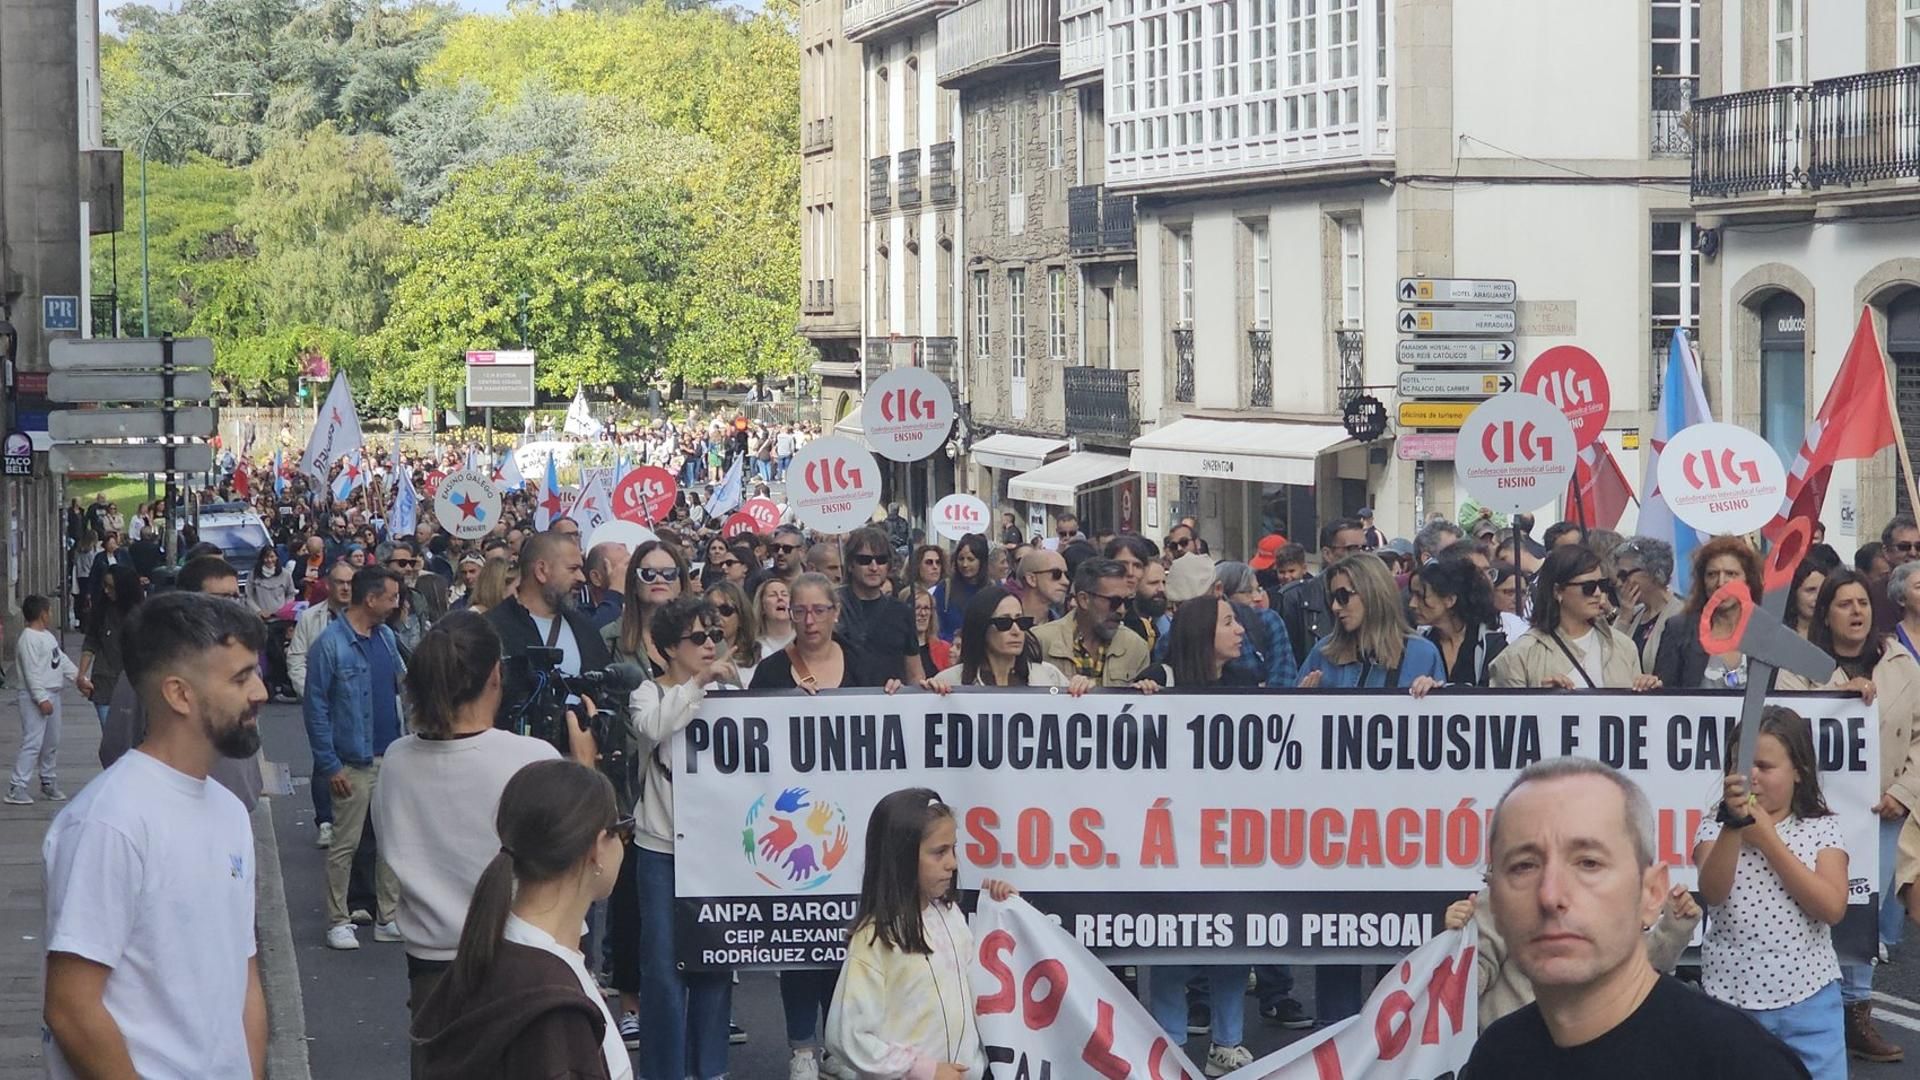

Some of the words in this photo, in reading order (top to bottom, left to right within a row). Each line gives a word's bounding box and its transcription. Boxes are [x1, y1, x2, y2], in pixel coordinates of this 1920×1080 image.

[48, 301, 72, 318] PR
[881, 388, 936, 422] CIG
[894, 432, 923, 442] ENSINO
[1482, 421, 1553, 463] CIG
[4, 457, 31, 466] TACO
[5, 466, 30, 474] BELL
[1683, 448, 1761, 490] CIG
[805, 457, 862, 494] CIG
[1498, 476, 1536, 488] ENSINO
[442, 474, 464, 500] ENSINO
[466, 473, 494, 498] GALEGO
[750, 504, 774, 522] CIG
[822, 502, 852, 514] ENSINO
[944, 504, 978, 520] CIG
[1709, 499, 1749, 513] ENSINO
[685, 716, 770, 774] POR
[788, 715, 907, 773] UNHA
[924, 704, 1168, 770] EDUCACIÓN
[1186, 714, 1303, 770] 100%
[1321, 714, 1542, 770] INCLUSIVA
[1599, 716, 1648, 770] DE
[1667, 714, 1867, 772] CADE
[965, 806, 1119, 868] S.O.S.
[1139, 797, 1178, 867] Á
[1200, 797, 1494, 868] EDUCACIÓ
[698, 903, 764, 923] ANPA
[724, 930, 765, 944] CEIP
[1076, 914, 1234, 948] RECORTES
[1246, 913, 1288, 948] DO
[702, 945, 806, 964] RODRÍGUEZ
